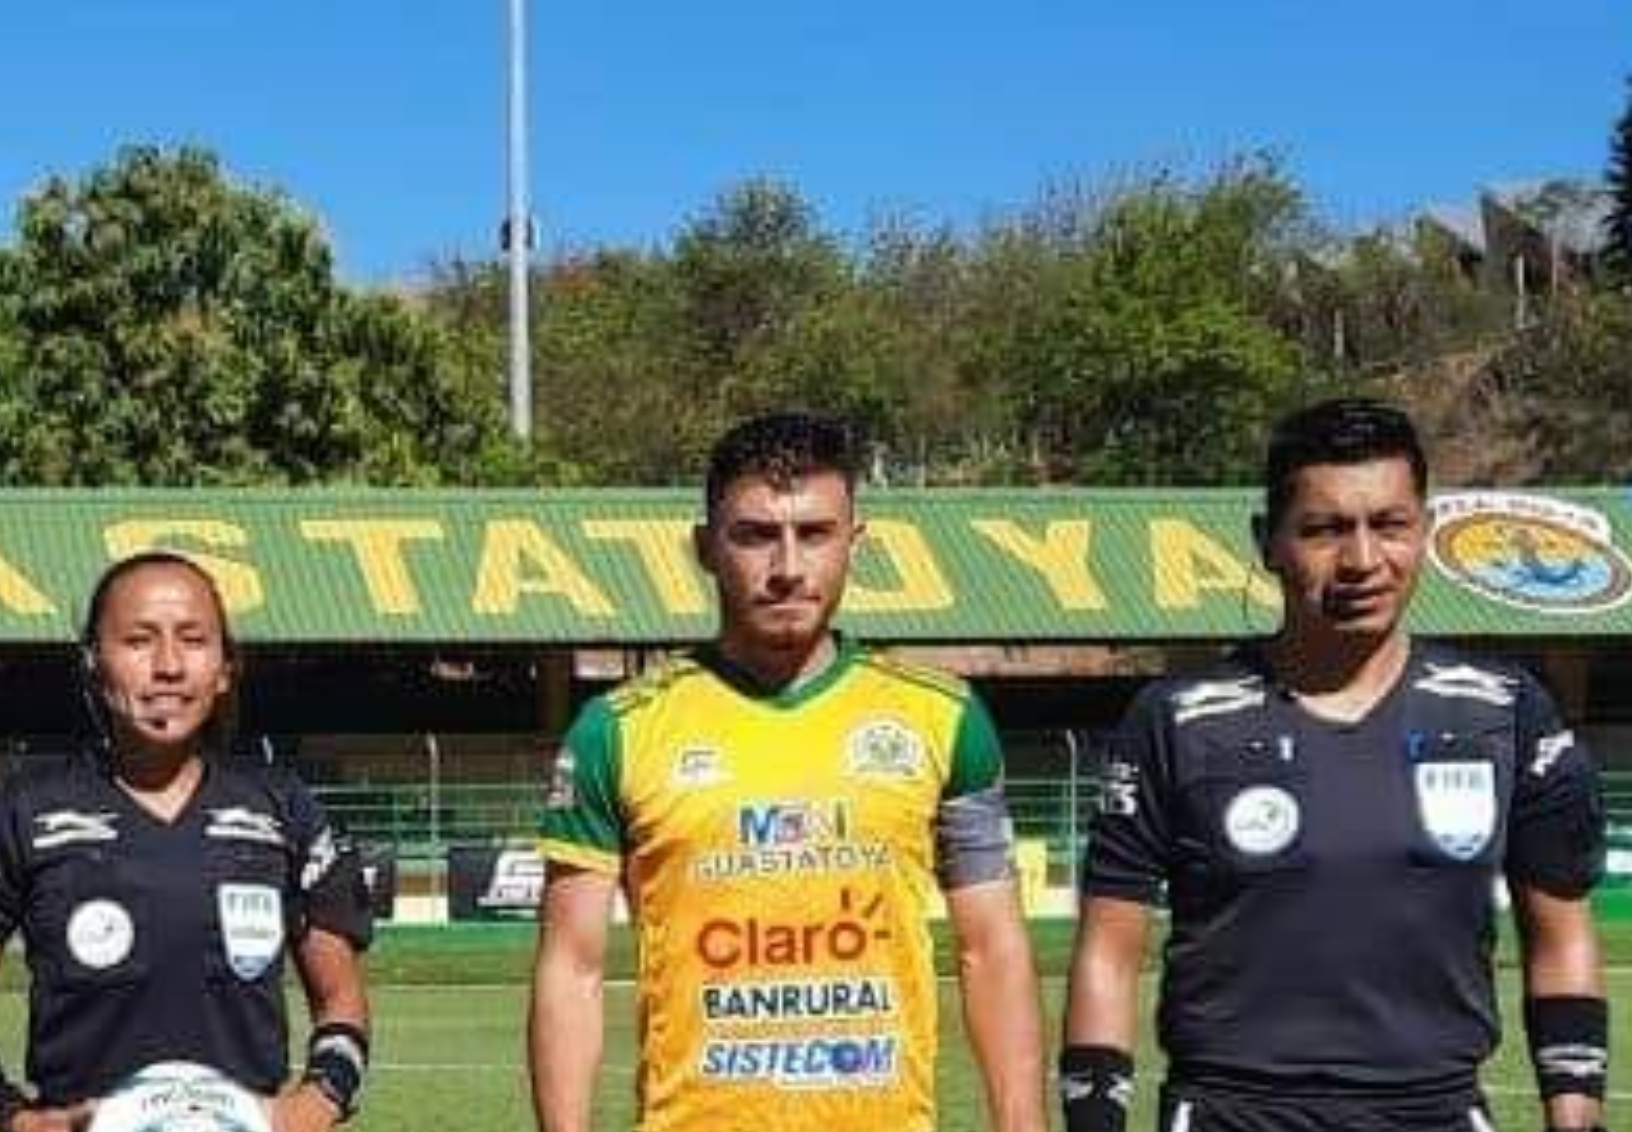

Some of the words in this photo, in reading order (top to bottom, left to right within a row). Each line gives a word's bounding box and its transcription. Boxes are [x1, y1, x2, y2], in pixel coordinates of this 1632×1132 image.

[696, 912, 868, 969] Claro
[702, 980, 891, 1019] BANRURAL
[702, 1036, 895, 1075] SISTECOM
